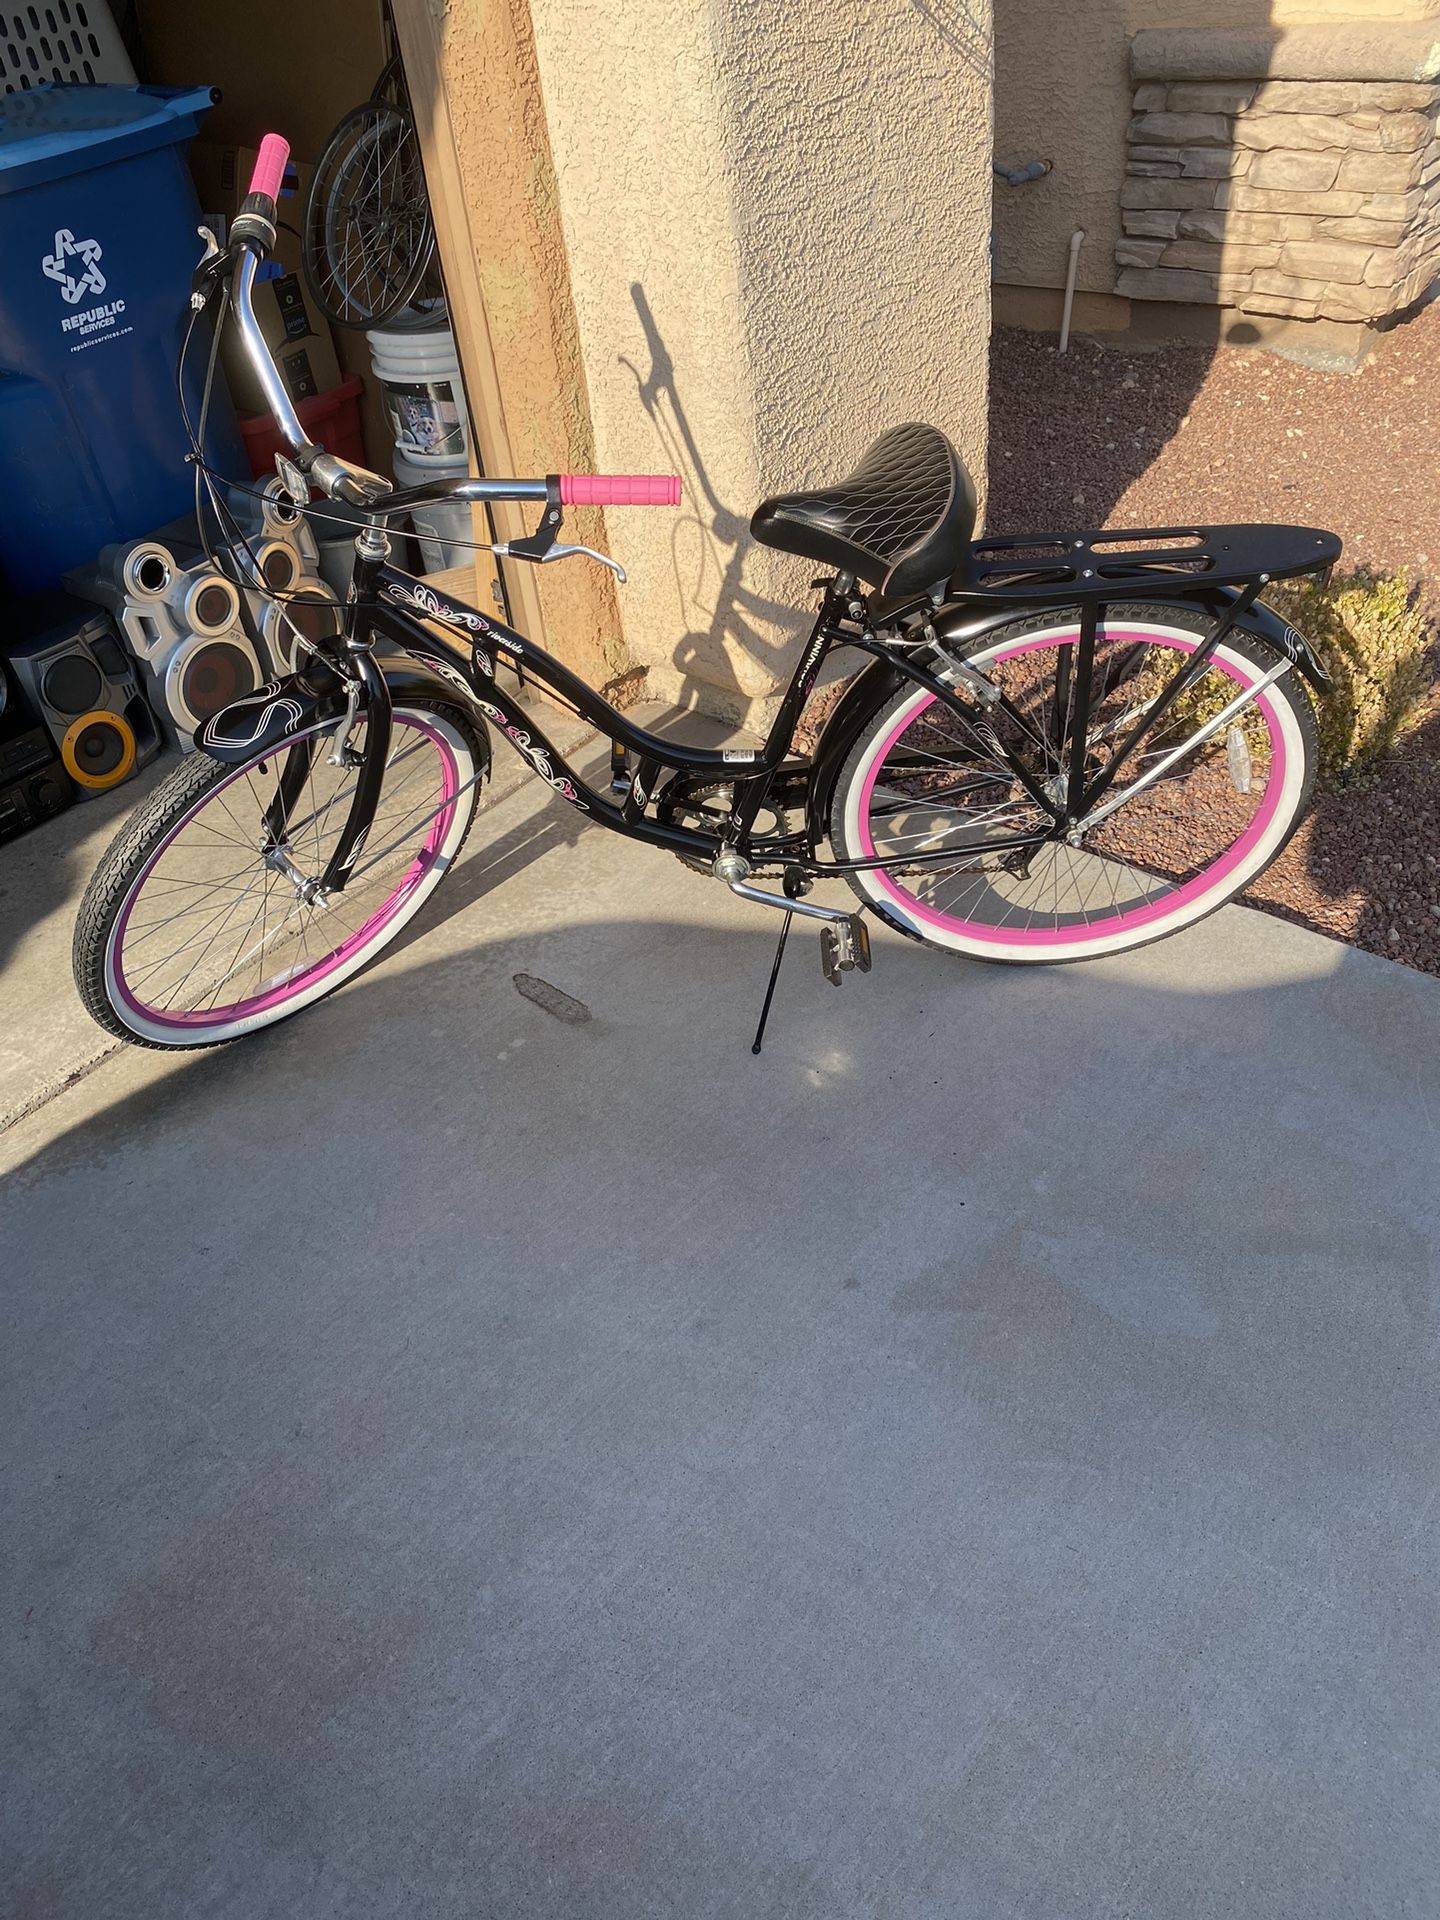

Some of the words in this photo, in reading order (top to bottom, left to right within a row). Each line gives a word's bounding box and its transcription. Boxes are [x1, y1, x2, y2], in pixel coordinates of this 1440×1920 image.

[61, 299, 126, 333] REPUBLIC
[79, 316, 116, 335] SERVICES
[70, 326, 134, 353] republicservices.com
[486, 631, 524, 654] riverside
